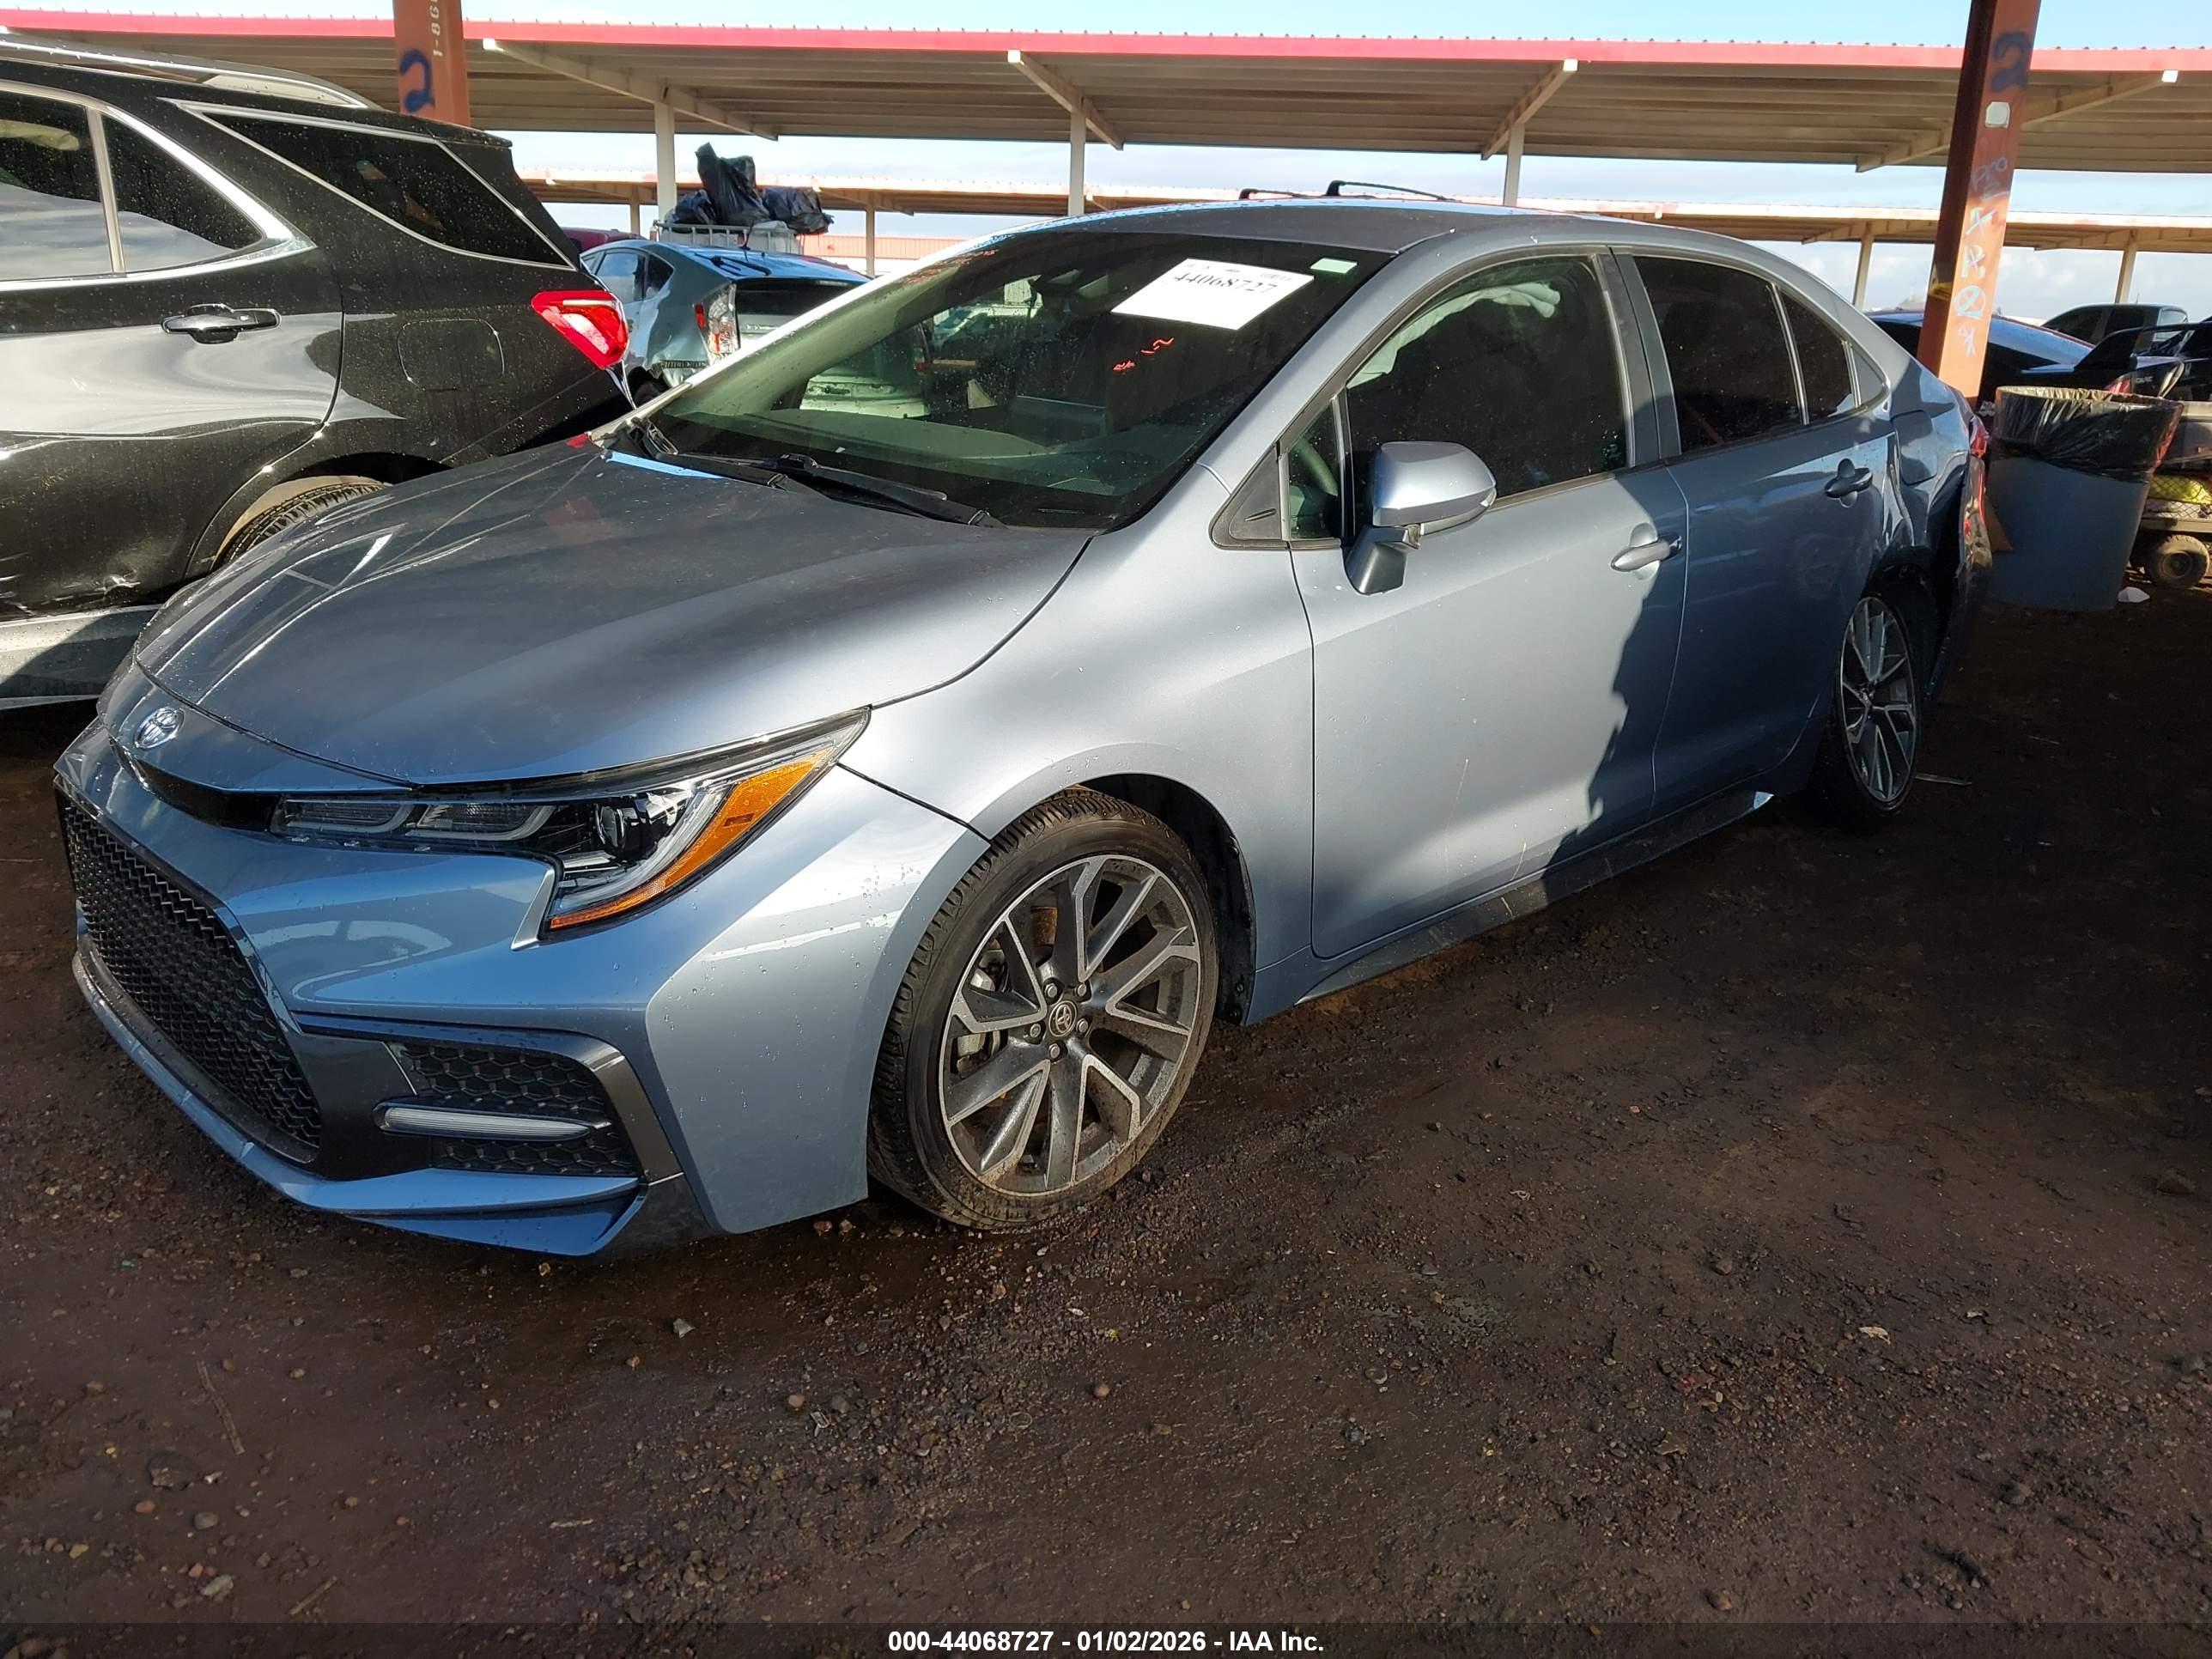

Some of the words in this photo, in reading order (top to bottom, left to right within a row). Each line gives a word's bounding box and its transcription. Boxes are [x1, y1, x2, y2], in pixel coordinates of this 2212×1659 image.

[398, 47, 435, 113] 2
[1990, 32, 2032, 93] 2
[1174, 271, 1279, 295] 44068727
